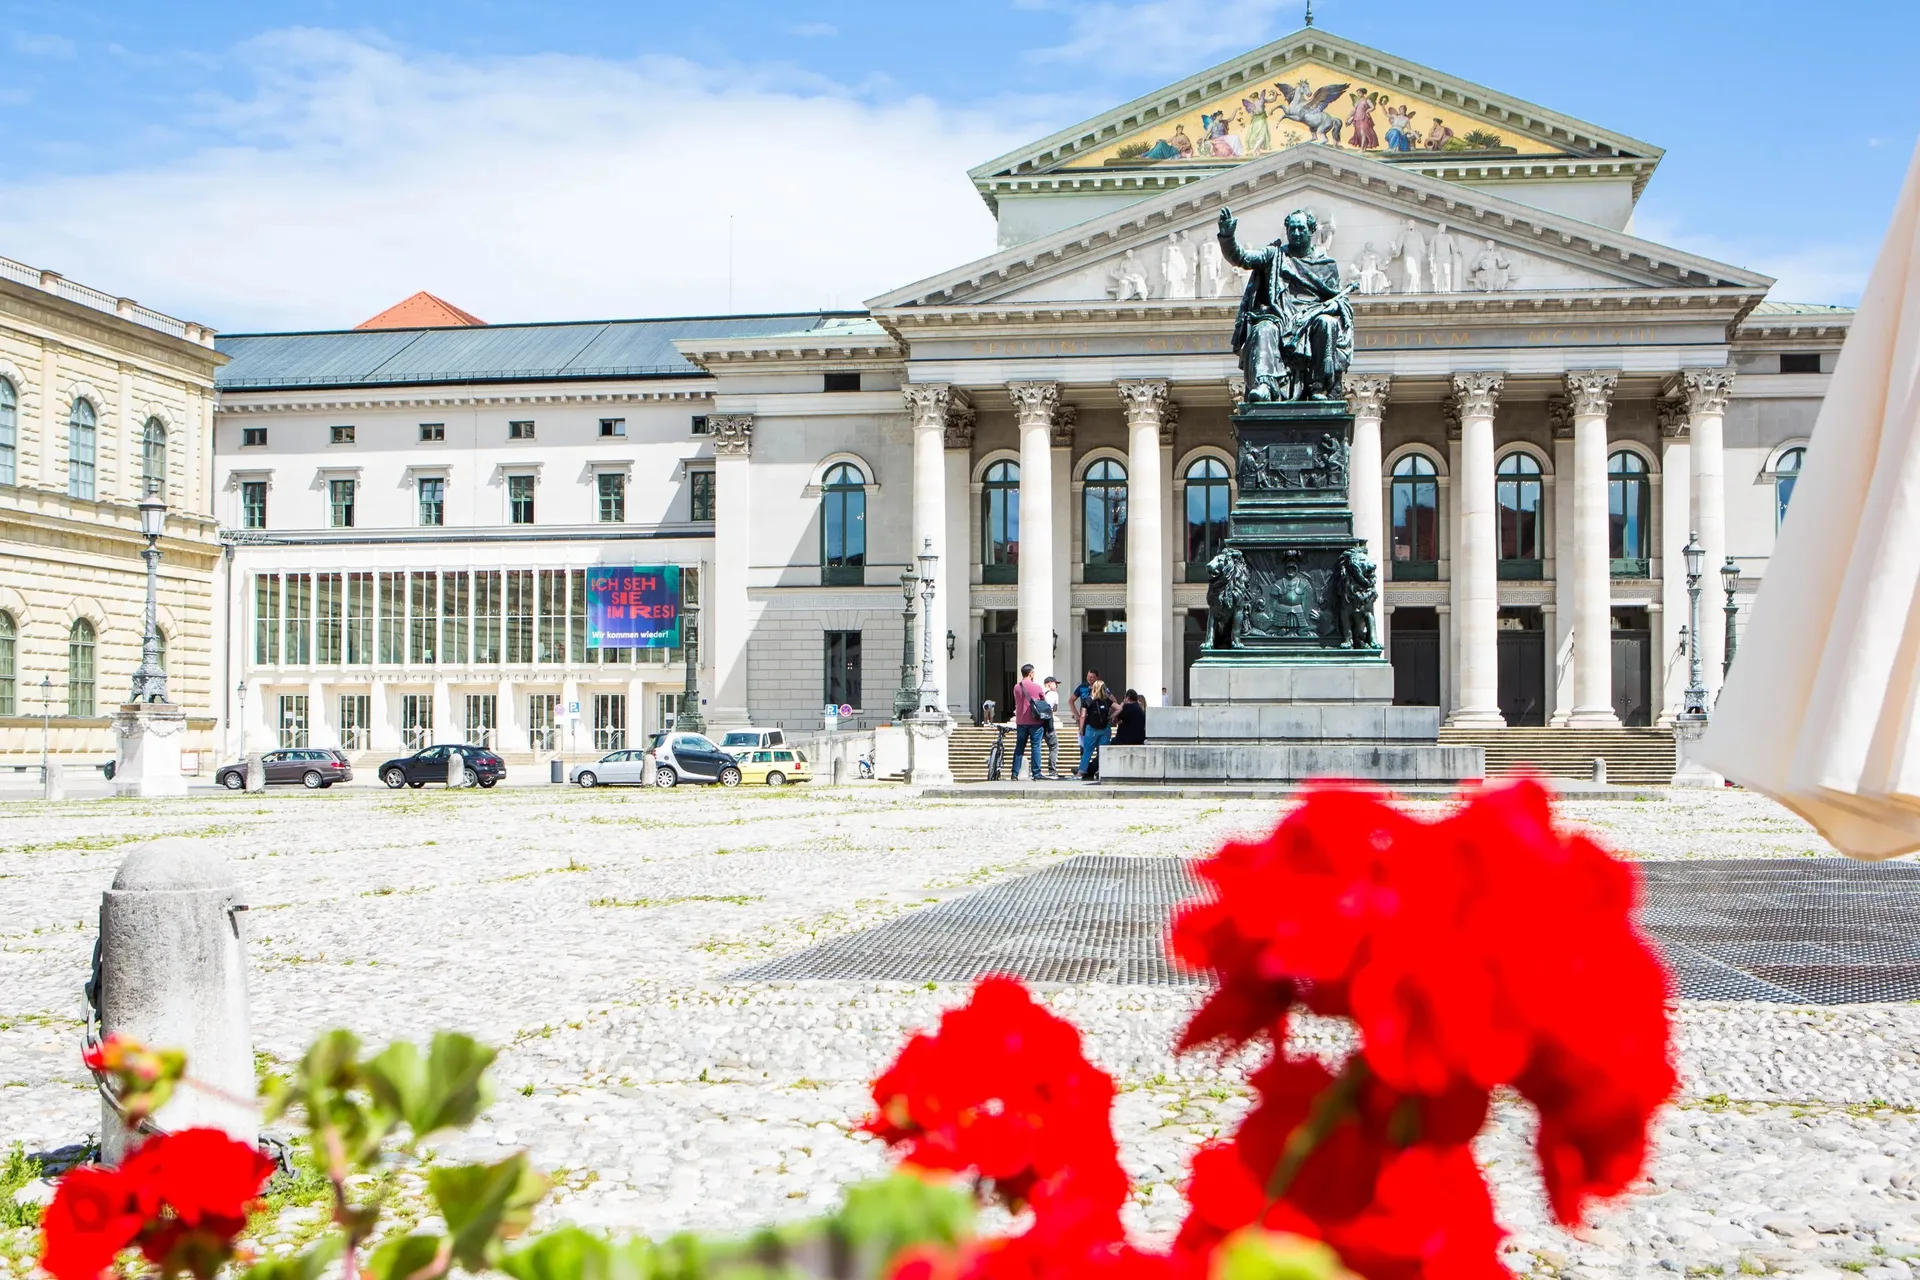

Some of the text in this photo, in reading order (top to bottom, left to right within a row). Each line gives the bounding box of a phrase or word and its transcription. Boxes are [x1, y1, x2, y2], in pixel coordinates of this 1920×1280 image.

[1365, 332, 1471, 346] DDITVM
[591, 577, 656, 591] ICH SEH
[611, 591, 642, 605] SIE
[607, 605, 675, 619] IM RESI
[592, 631, 669, 639] Wir kommen wieder!
[354, 673, 592, 682] BAYERISCHES STAATSSCHAUSPIEL
